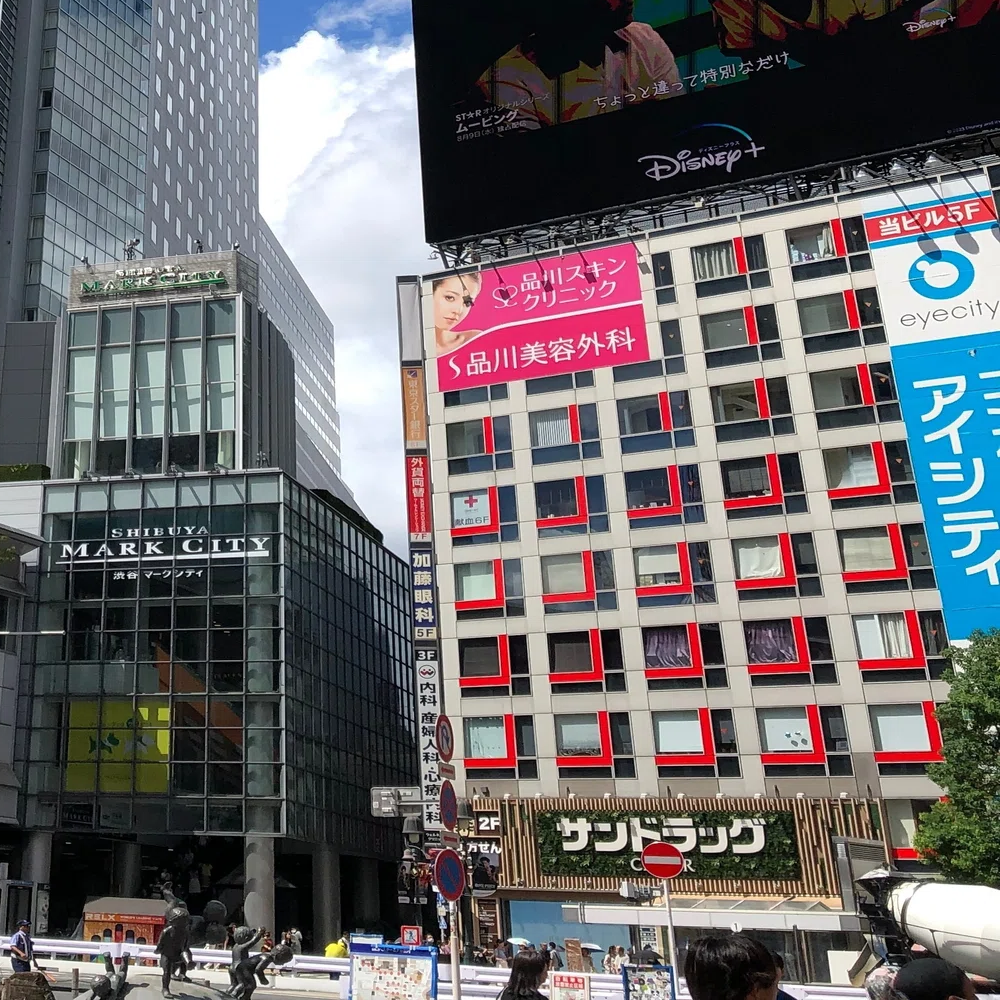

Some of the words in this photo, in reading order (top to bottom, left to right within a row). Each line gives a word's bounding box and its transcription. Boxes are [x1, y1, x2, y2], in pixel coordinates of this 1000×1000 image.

[594, 51, 789, 109] ちょっと違って特別なだけ
[456, 108, 519, 133] ムービング
[879, 202, 980, 237] 当ビル5F
[80, 275, 154, 294] MARK
[160, 269, 223, 285] CITY
[521, 258, 627, 292] 品川スキン
[523, 280, 617, 311] クリニック
[901, 299, 1000, 330] eyecity
[466, 327, 636, 377] 品川美容外科
[408, 380, 421, 439] 東京スター銀行
[411, 457, 425, 498] 外貨両替
[913, 375, 1000, 586] アイシティ
[111, 526, 209, 538] SHIBUYA
[455, 516, 489, 526] 献血6F
[60, 541, 165, 558] MARK
[182, 537, 270, 553] CITY
[412, 553, 434, 623] 加藤眼科
[416, 628, 434, 637] 5F
[417, 650, 435, 660] 3F
[478, 817, 501, 831] 2F
[557, 817, 766, 854] サンドラッグ
